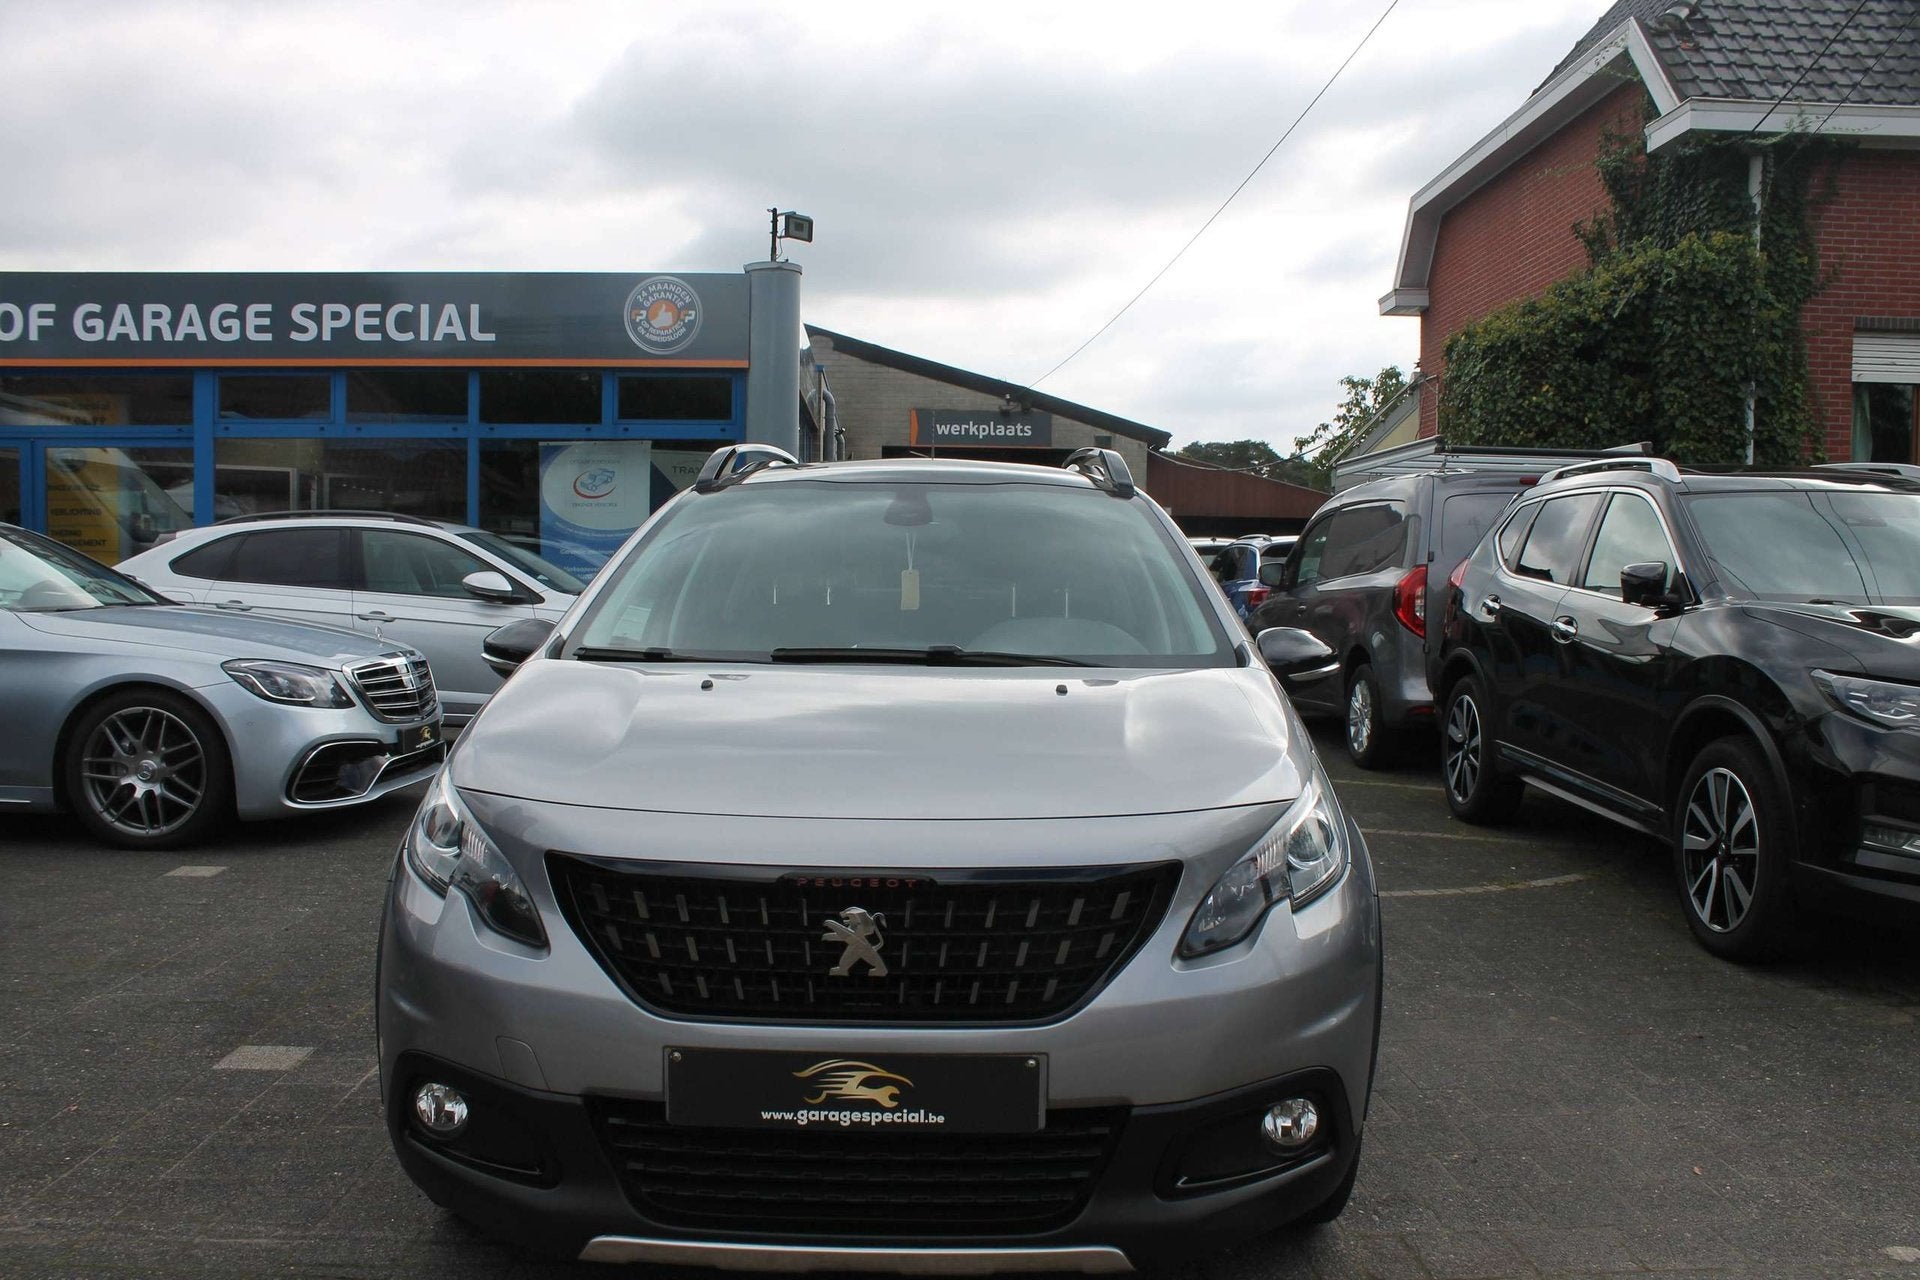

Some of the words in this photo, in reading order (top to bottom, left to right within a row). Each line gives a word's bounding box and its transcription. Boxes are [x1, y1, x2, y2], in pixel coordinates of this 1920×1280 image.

[636, 290, 648, 302] 24
[648, 282, 692, 304] MAANDEN
[643, 291, 685, 308] GARANTIE
[0, 303, 56, 341] OF
[73, 303, 273, 341] GARAGE
[290, 303, 496, 342] SPECIAL
[637, 326, 646, 336] EN
[641, 320, 650, 329] OP
[936, 421, 1032, 439] werkplaats
[797, 877, 917, 888] PEUGEOT
[761, 1108, 945, 1127] www.garagespecial.be
